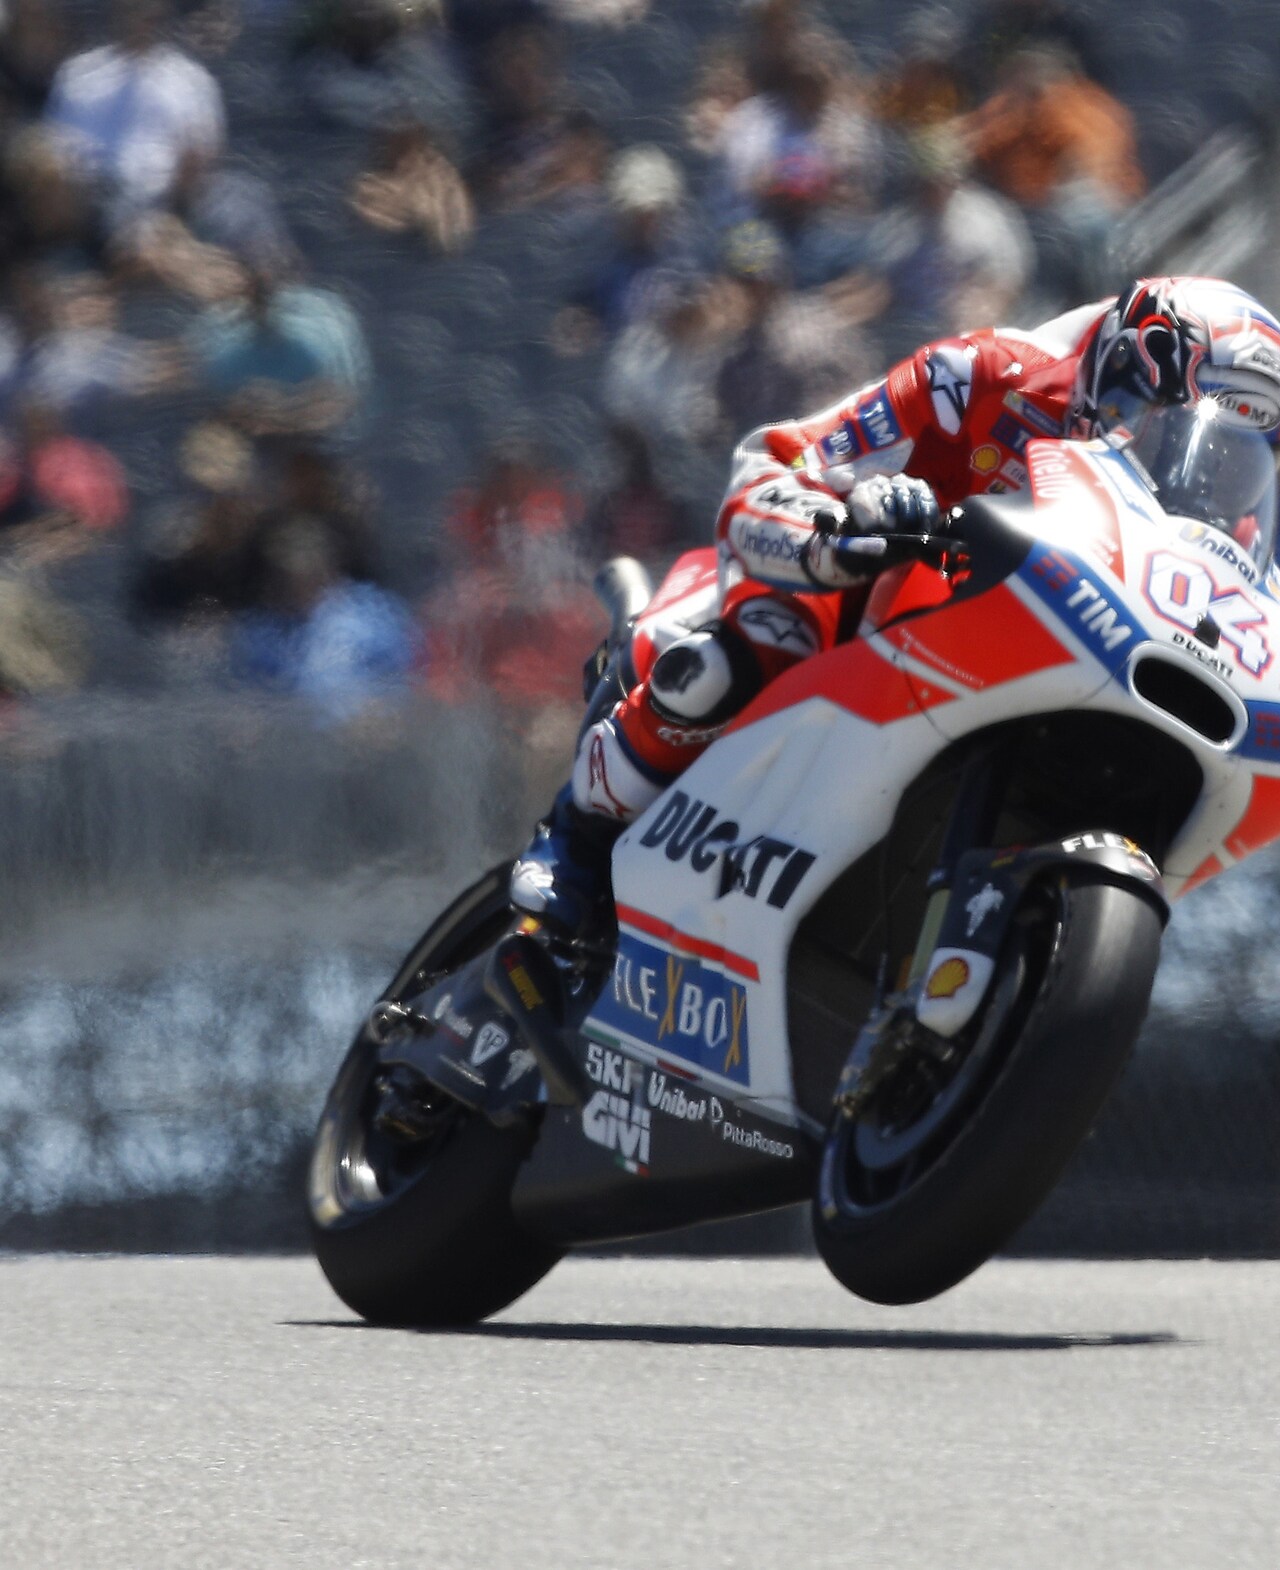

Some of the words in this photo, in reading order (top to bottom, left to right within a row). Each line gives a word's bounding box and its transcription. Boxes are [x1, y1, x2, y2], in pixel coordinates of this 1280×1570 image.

[863, 400, 897, 448] TIM
[1065, 577, 1133, 652] TIM
[1141, 549, 1275, 683] 04
[639, 789, 818, 909] DUCATI
[614, 951, 747, 1074] FLEXBOX
[582, 1089, 650, 1165] GIVI
[722, 1121, 795, 1159] PittaRosso
